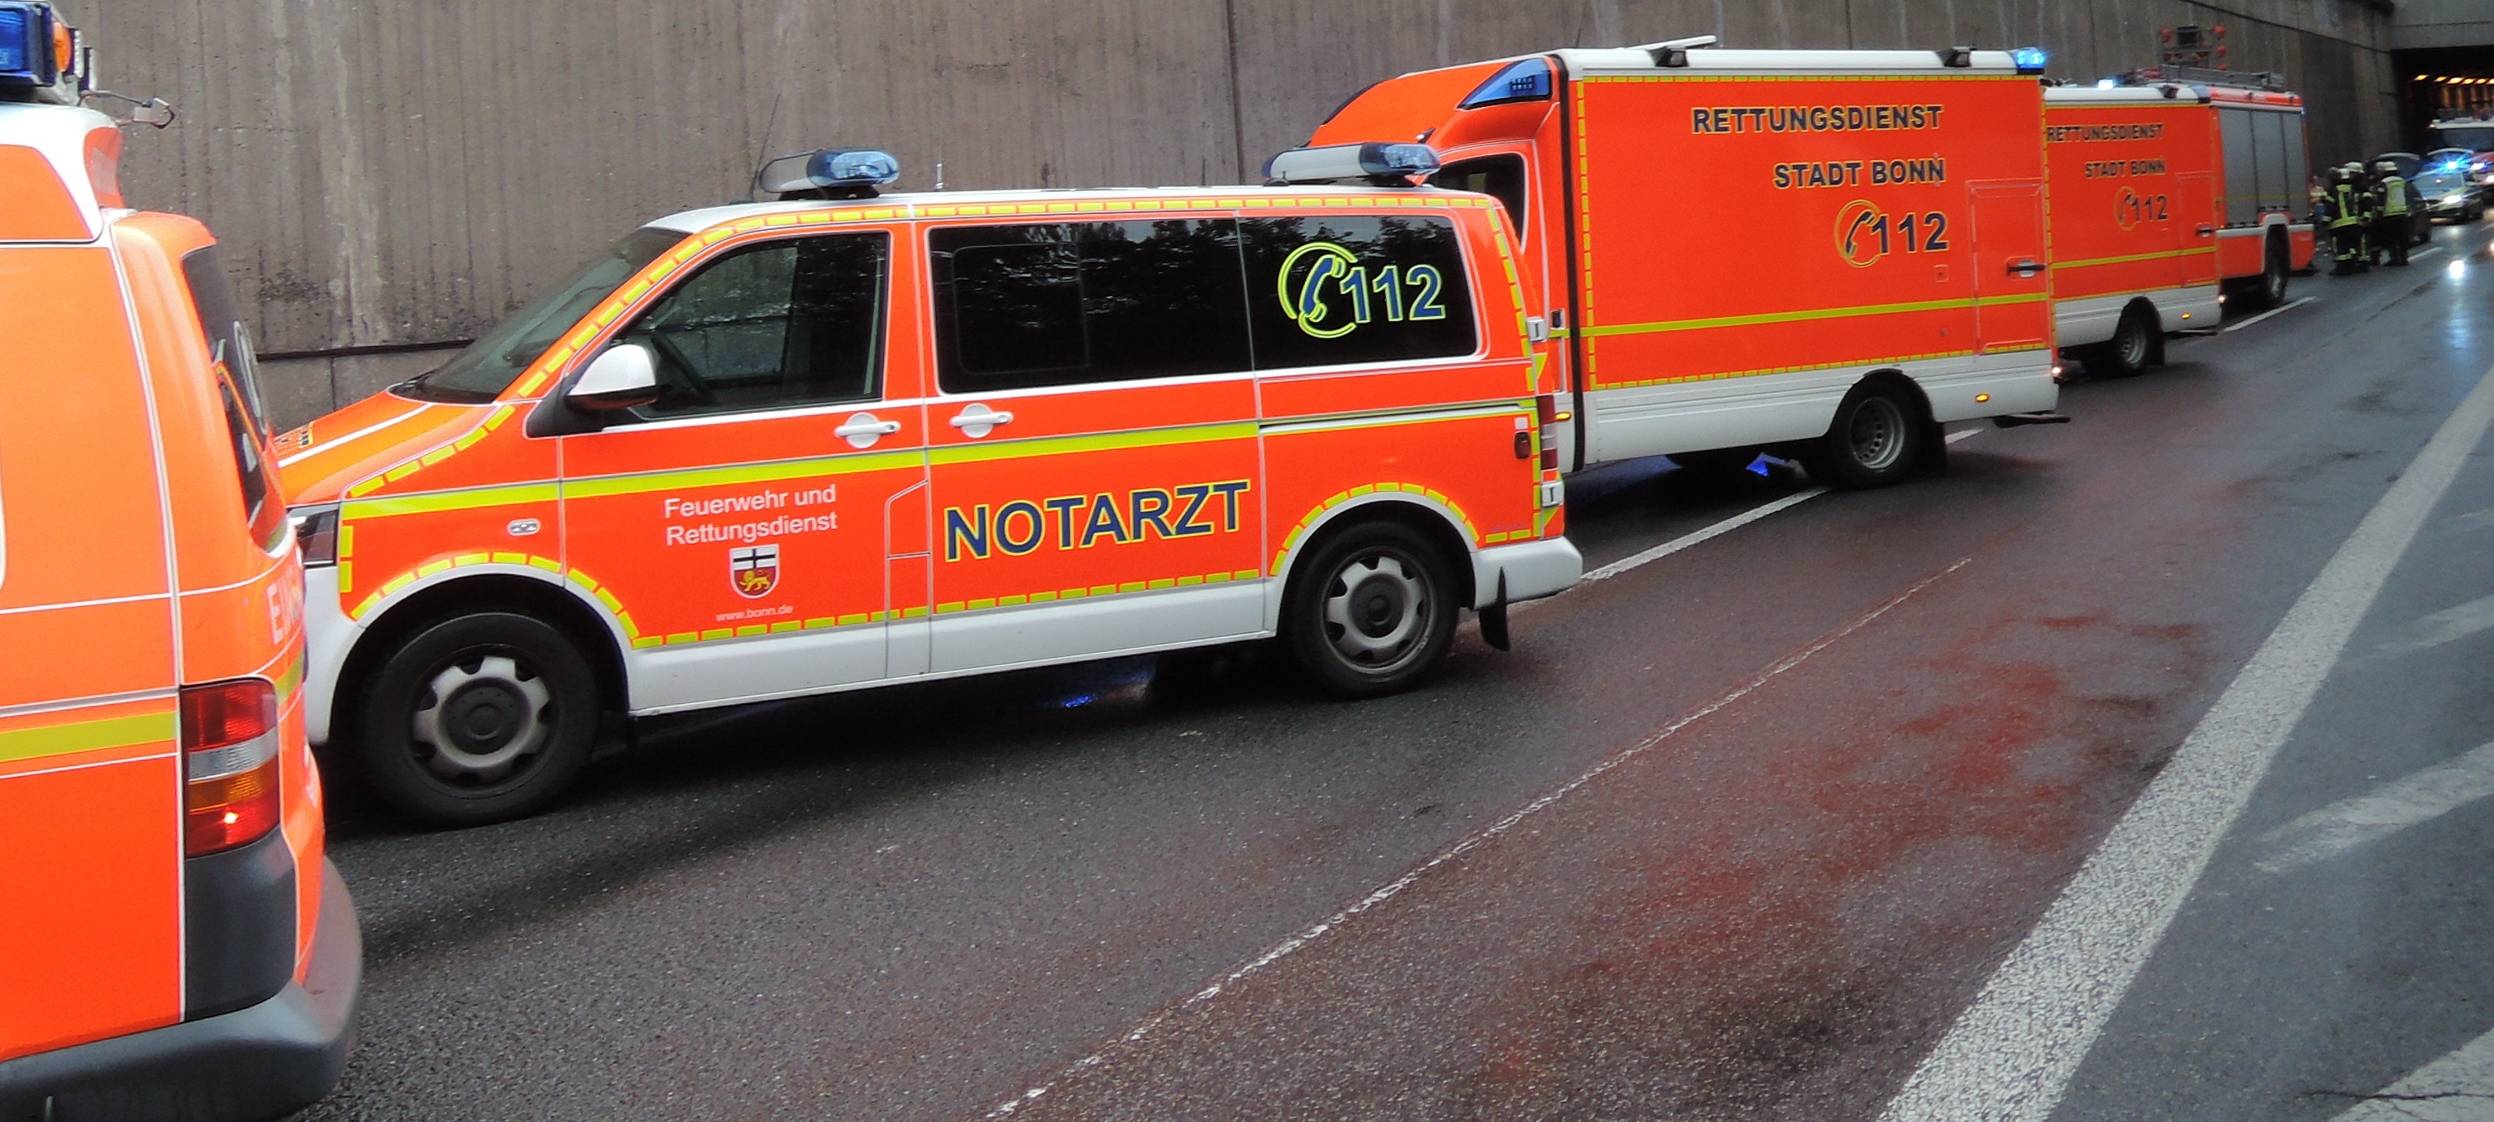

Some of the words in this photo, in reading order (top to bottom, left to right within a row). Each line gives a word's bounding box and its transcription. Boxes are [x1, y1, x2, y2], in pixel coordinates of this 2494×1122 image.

[1692, 105, 1943, 134] RETTUNGSDIENST
[2046, 124, 2163, 142] RETTUNGSDIENST
[1773, 160, 1863, 189] STADT
[1871, 158, 1946, 186] BONN
[2085, 161, 2126, 177] STADT
[2131, 158, 2165, 175] BONN
[2131, 194, 2168, 222] 112
[1871, 211, 1948, 255] 112
[1340, 264, 1446, 323] 112
[664, 490, 789, 518] Feuerwehr
[794, 484, 836, 505] und
[666, 511, 838, 545] Rettungsdienst
[944, 479, 1250, 562] NOTARZT
[716, 605, 793, 621] www.bonn.de
